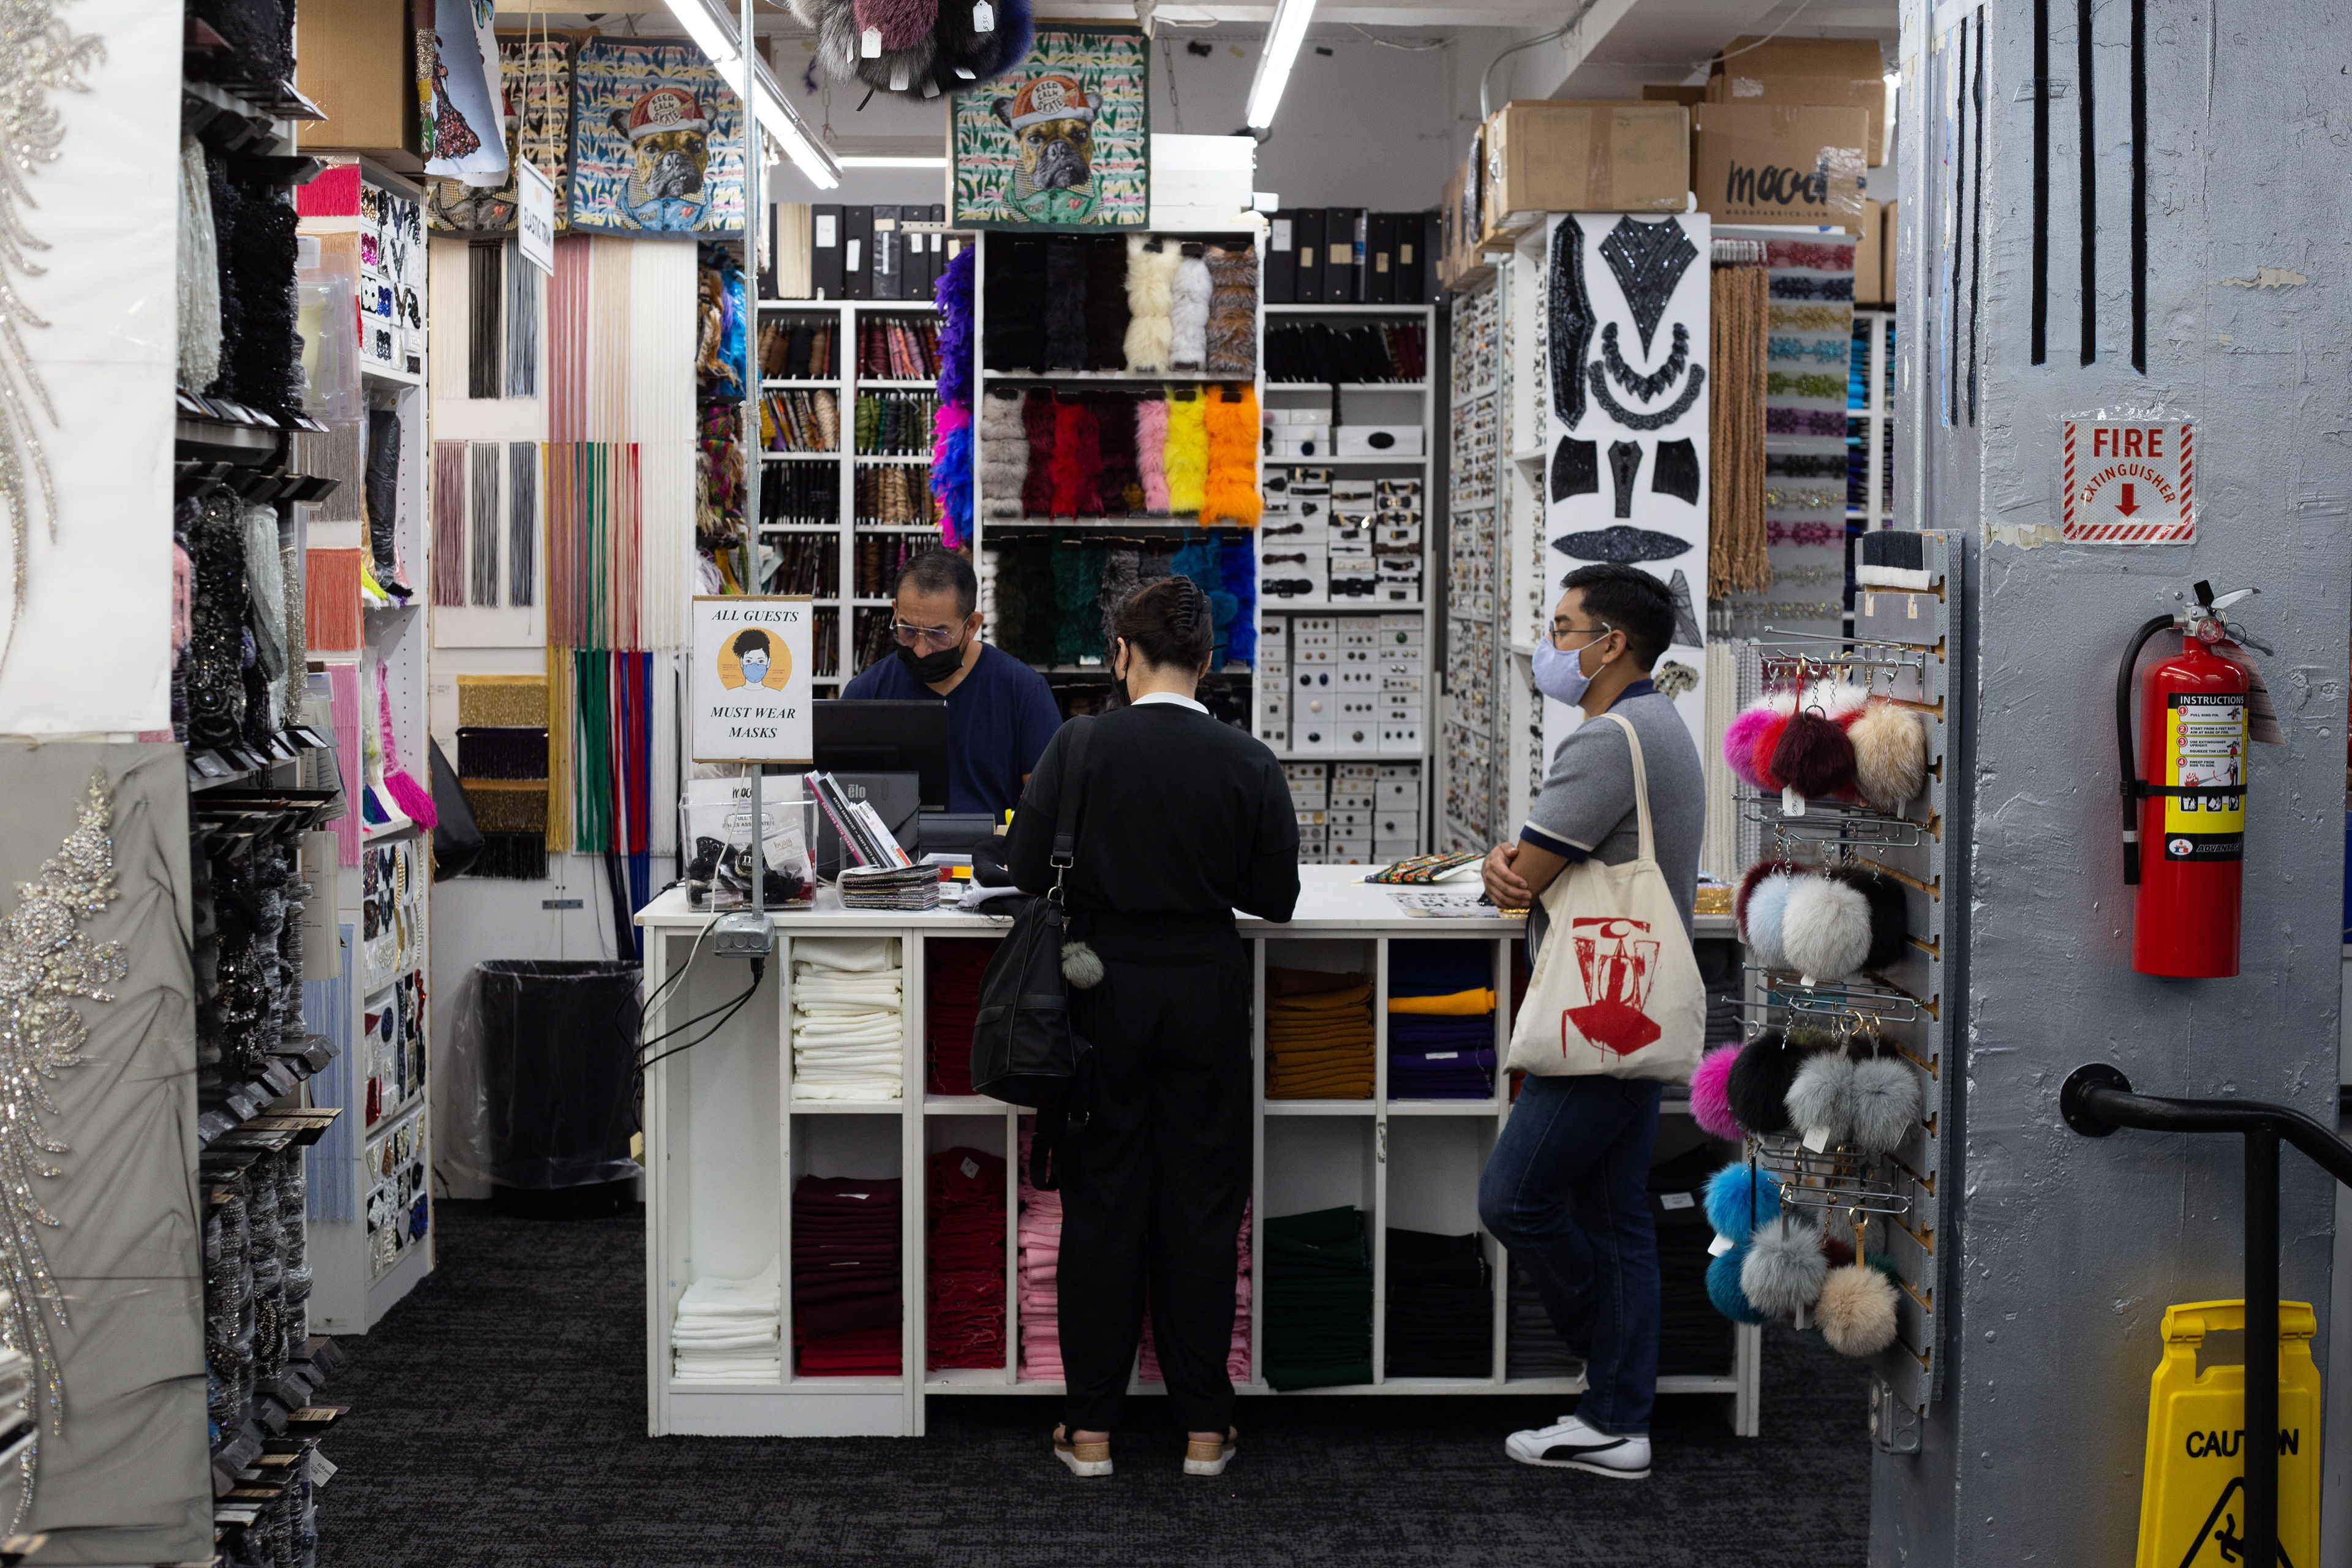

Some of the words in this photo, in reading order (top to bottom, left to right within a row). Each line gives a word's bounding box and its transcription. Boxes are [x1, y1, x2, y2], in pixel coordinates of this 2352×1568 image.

[1036, 97, 1063, 113] SKATE
[653, 110, 679, 124] SKATE
[1727, 157, 1830, 206] mood
[524, 206, 541, 241] ELASTIC
[541, 221, 551, 249] TRIM
[2093, 428, 2163, 458] FIRE
[2079, 463, 2177, 504] EXTINGUISHER
[712, 610, 739, 621] ALL
[744, 610, 799, 622] GUESTS
[2180, 696, 2244, 704] INSTRUCTIONS
[710, 706, 752, 718] MUST
[756, 708, 796, 719] WEAR
[728, 726, 778, 739] MASKS
[821, 802, 836, 824] COLORING
[841, 834, 855, 853] THREAD
[832, 797, 843, 812] ANTON
[857, 833, 873, 858] HEAVY-DUTY
[2196, 843, 2242, 853] ADVANTAGE
[2186, 1428, 2299, 1458] CAUN
